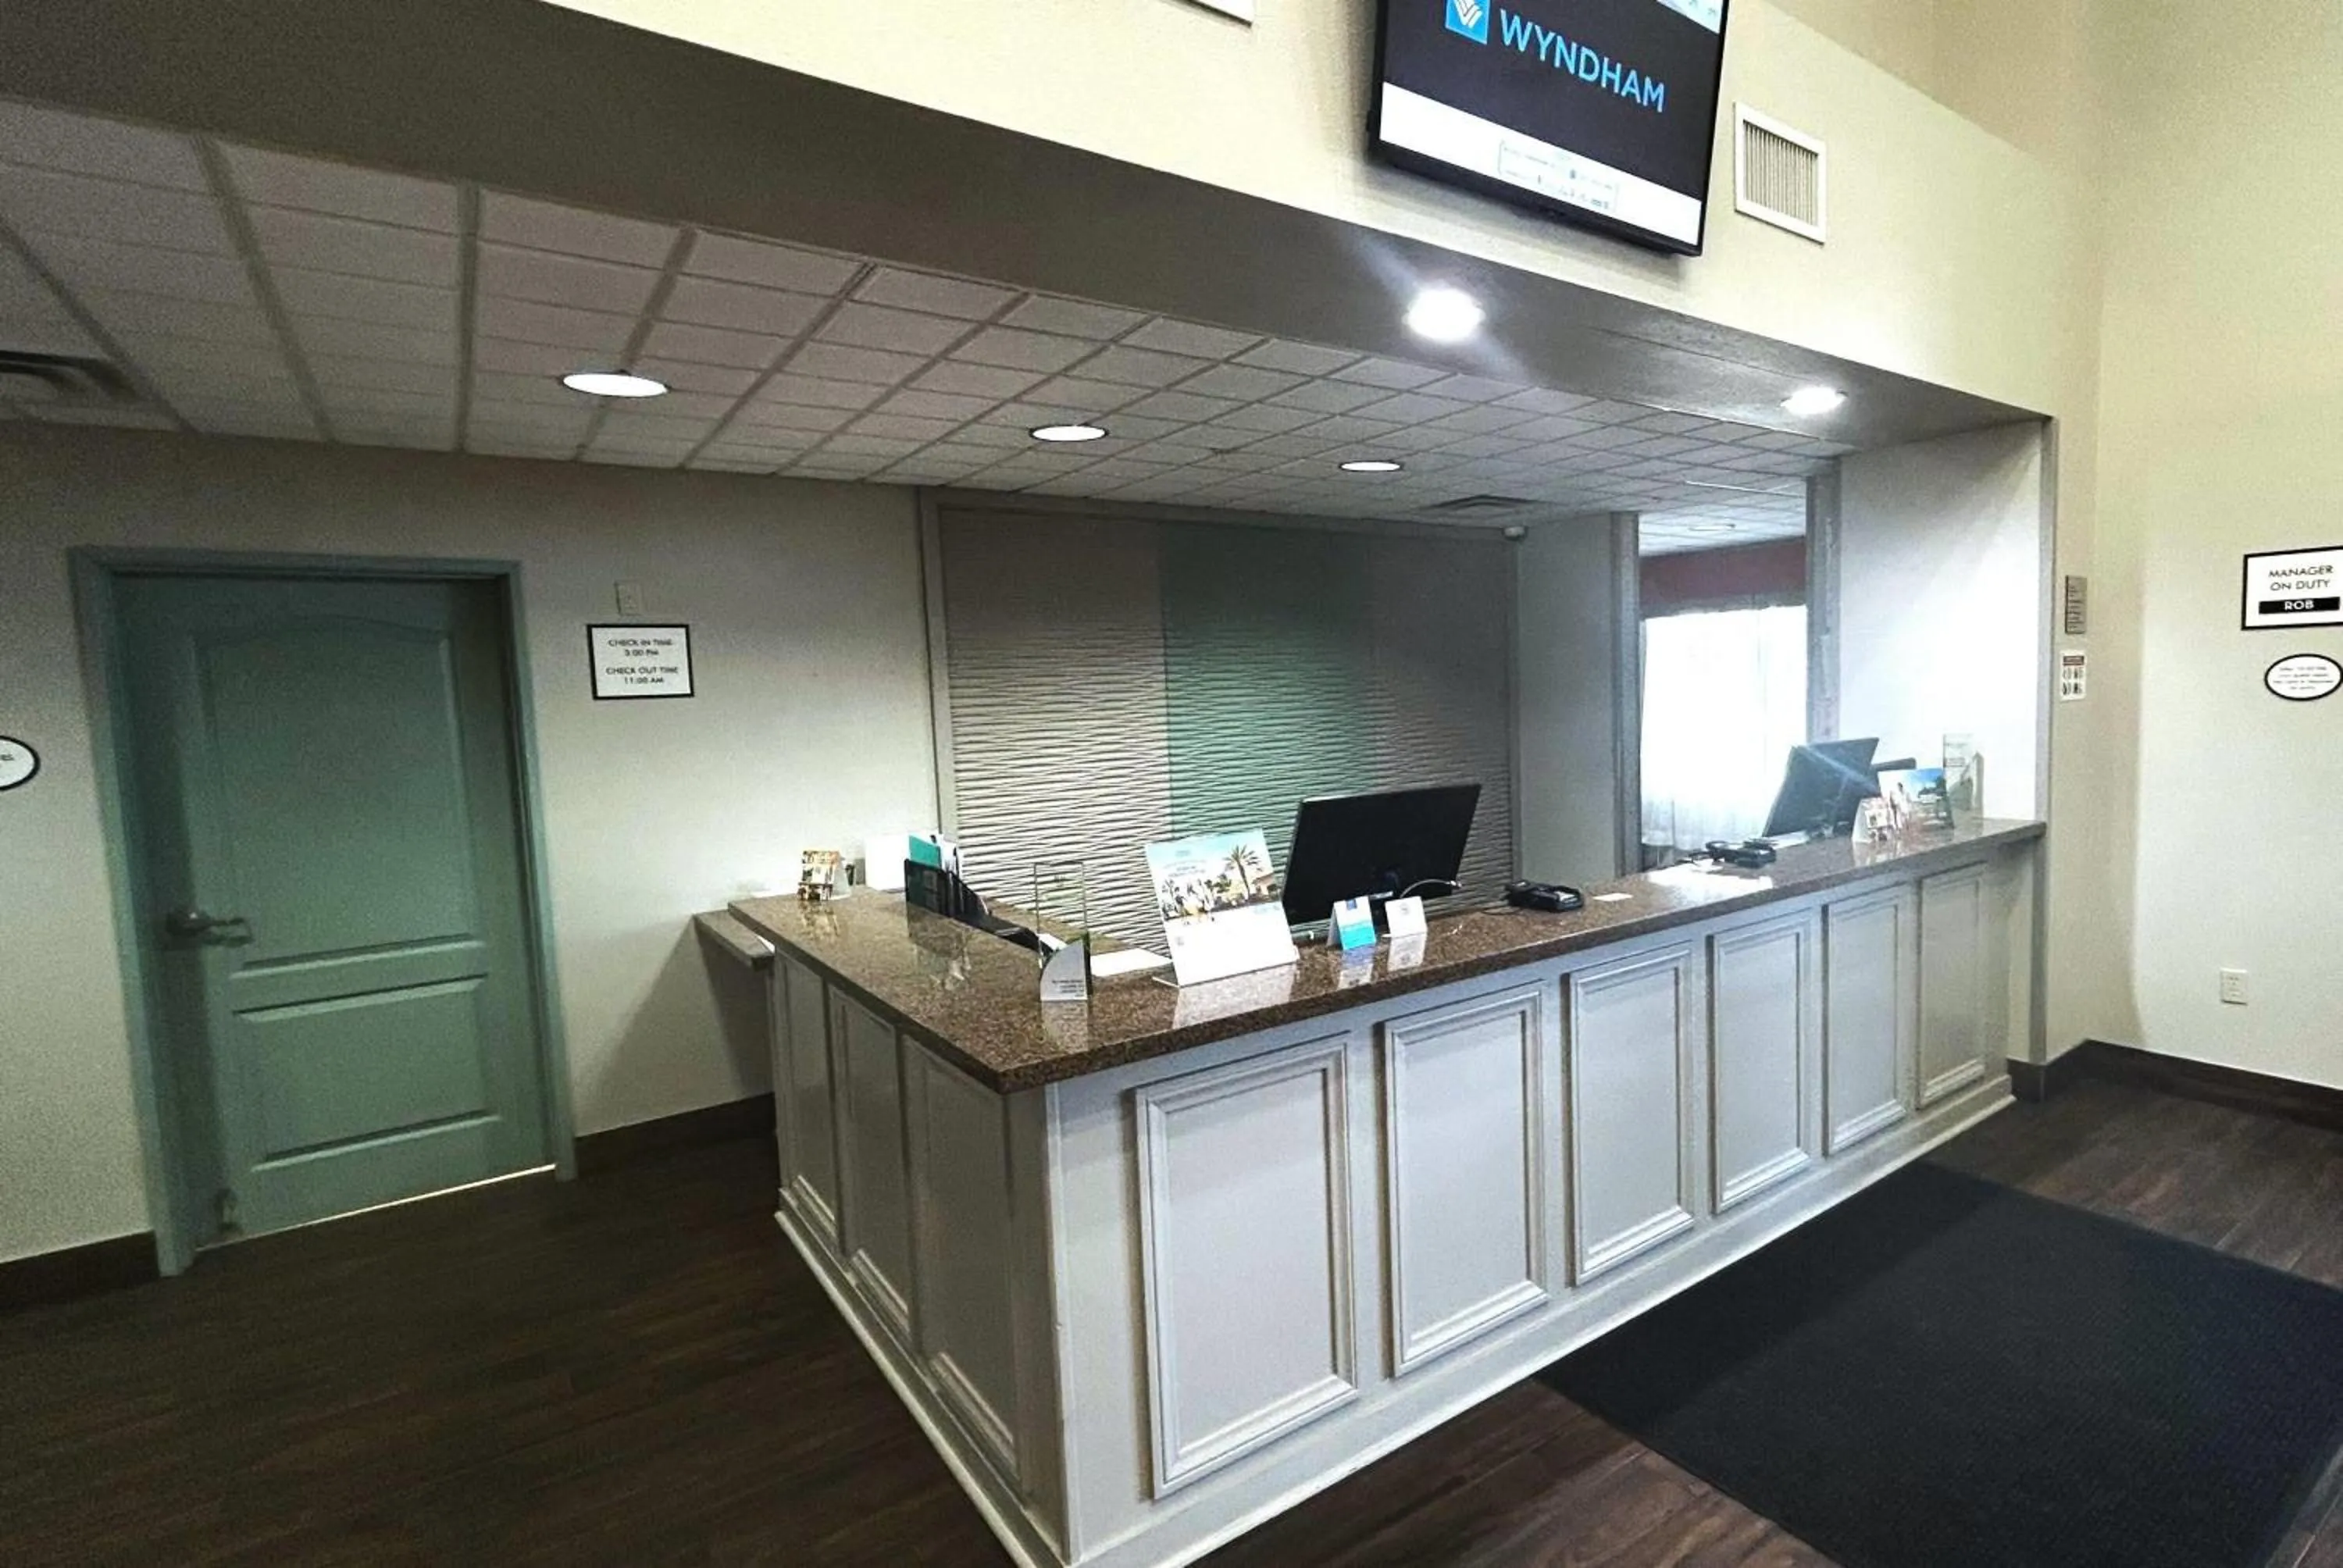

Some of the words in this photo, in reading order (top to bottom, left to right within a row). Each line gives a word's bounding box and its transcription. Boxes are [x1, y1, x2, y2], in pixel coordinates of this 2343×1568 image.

[1500, 9, 1665, 113] WYNDHAM
[2268, 565, 2334, 577] MANAGER
[2270, 582, 2291, 591] ON
[2295, 579, 2331, 590] DUTY
[2284, 600, 2314, 610] ROB
[606, 666, 636, 675] CHECK
